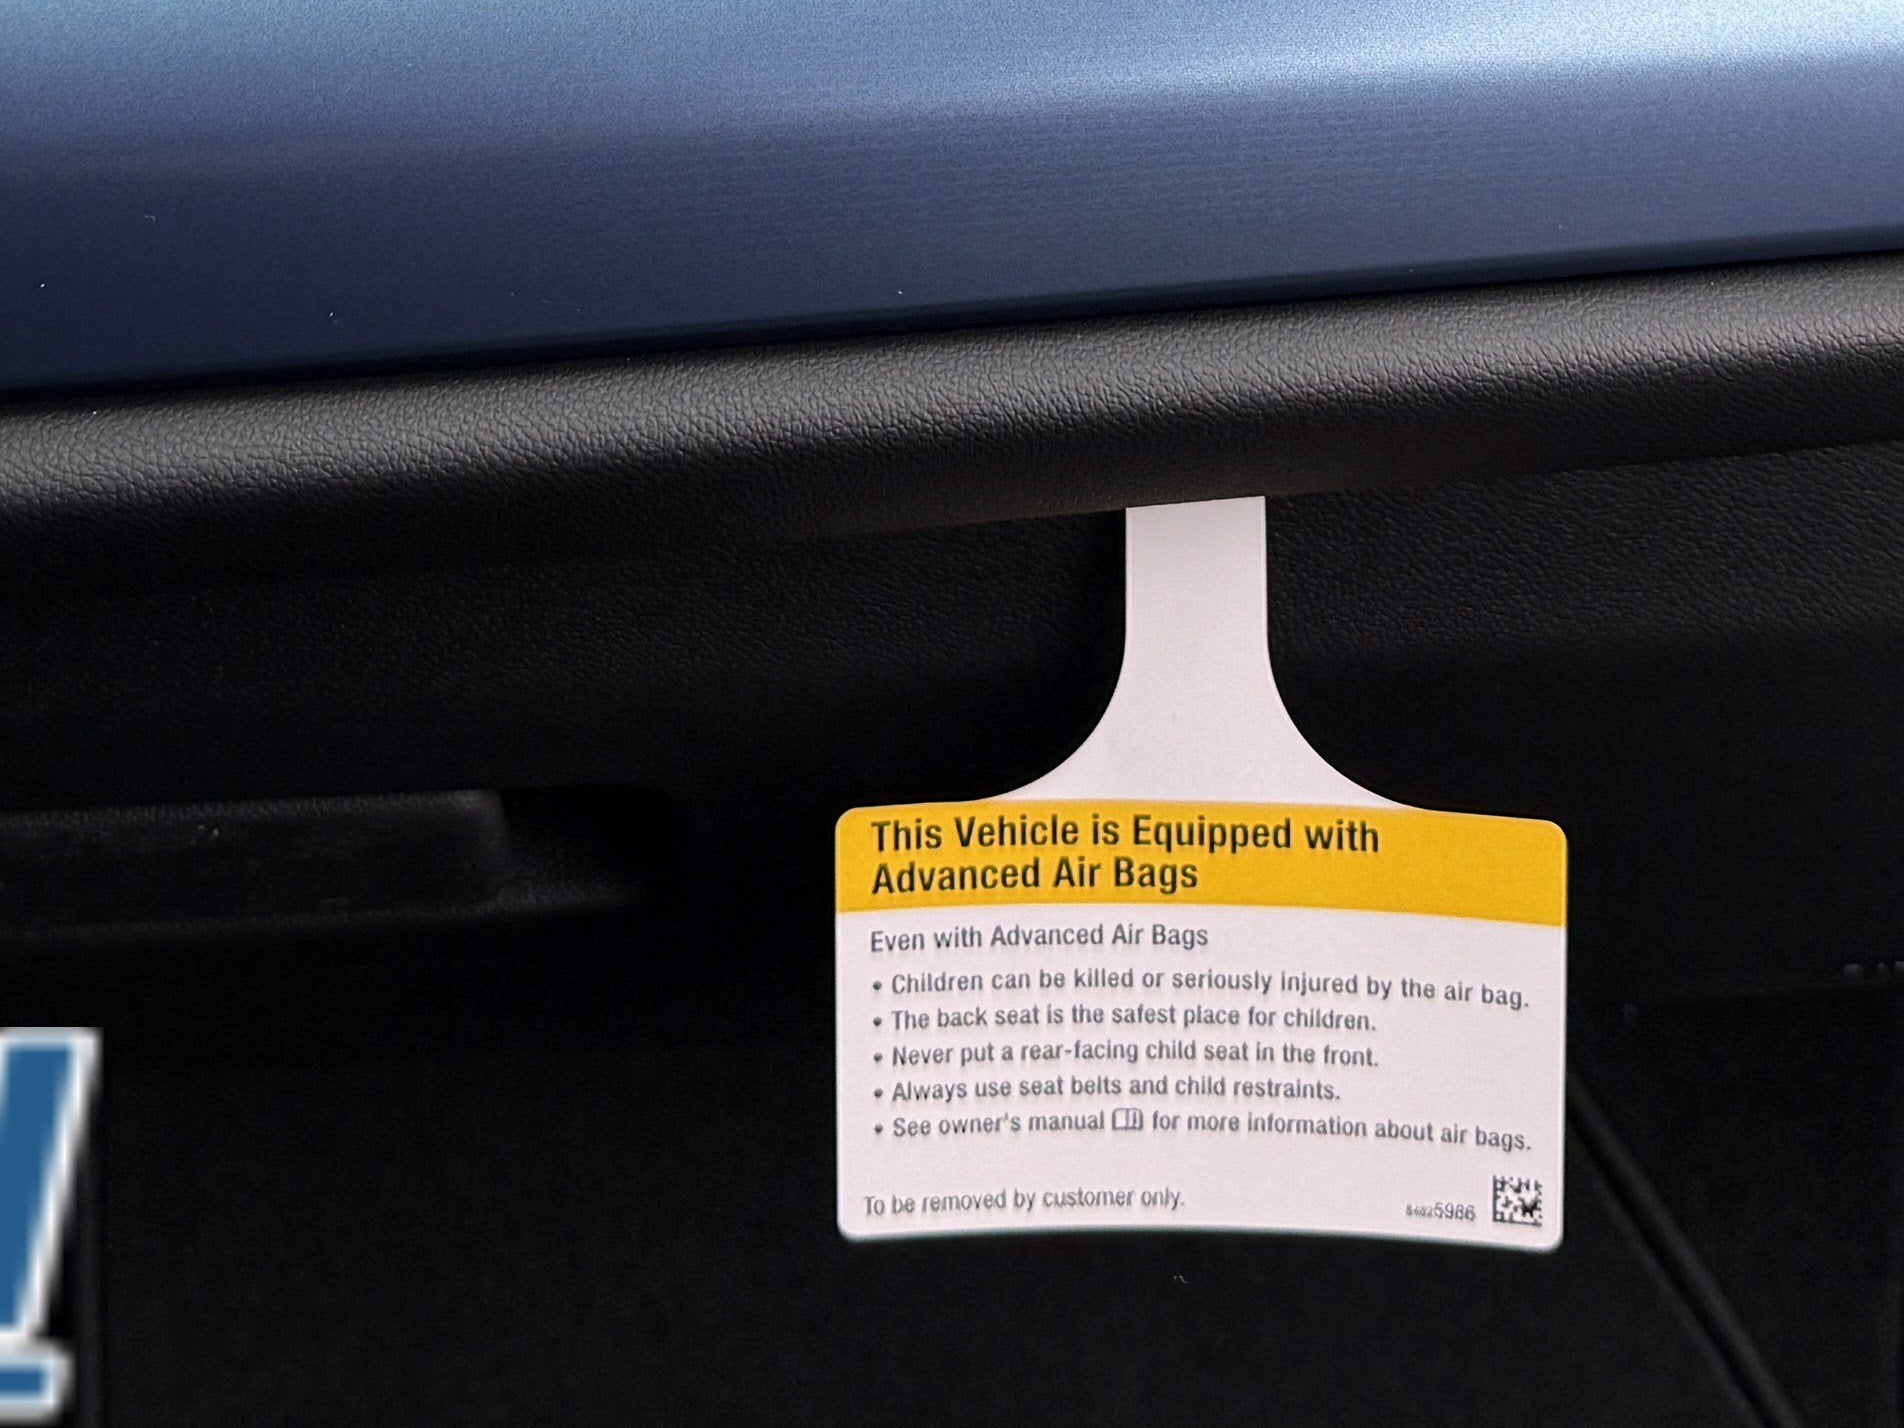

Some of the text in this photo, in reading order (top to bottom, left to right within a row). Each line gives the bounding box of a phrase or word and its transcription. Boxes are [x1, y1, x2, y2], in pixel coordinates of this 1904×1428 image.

[871, 813, 1380, 853] This Vehicle is Equipped with
[871, 855, 1199, 895] Advanced Air Bags
[870, 923, 1209, 952] Even with Advanced Air Bags
[891, 968, 1530, 1011] Children can be killed or seriously injured by the air bag.
[891, 1003, 1377, 1032] The back seat is the safest place for children.
[892, 1039, 1380, 1068] Never put a rear-facing child seat in the front.
[892, 1075, 1342, 1102] Always use seat belts and child restraints.
[893, 1110, 1532, 1153] See owner's manual for more information about air bags.
[864, 1187, 1186, 1216] To be removed by customer only.
